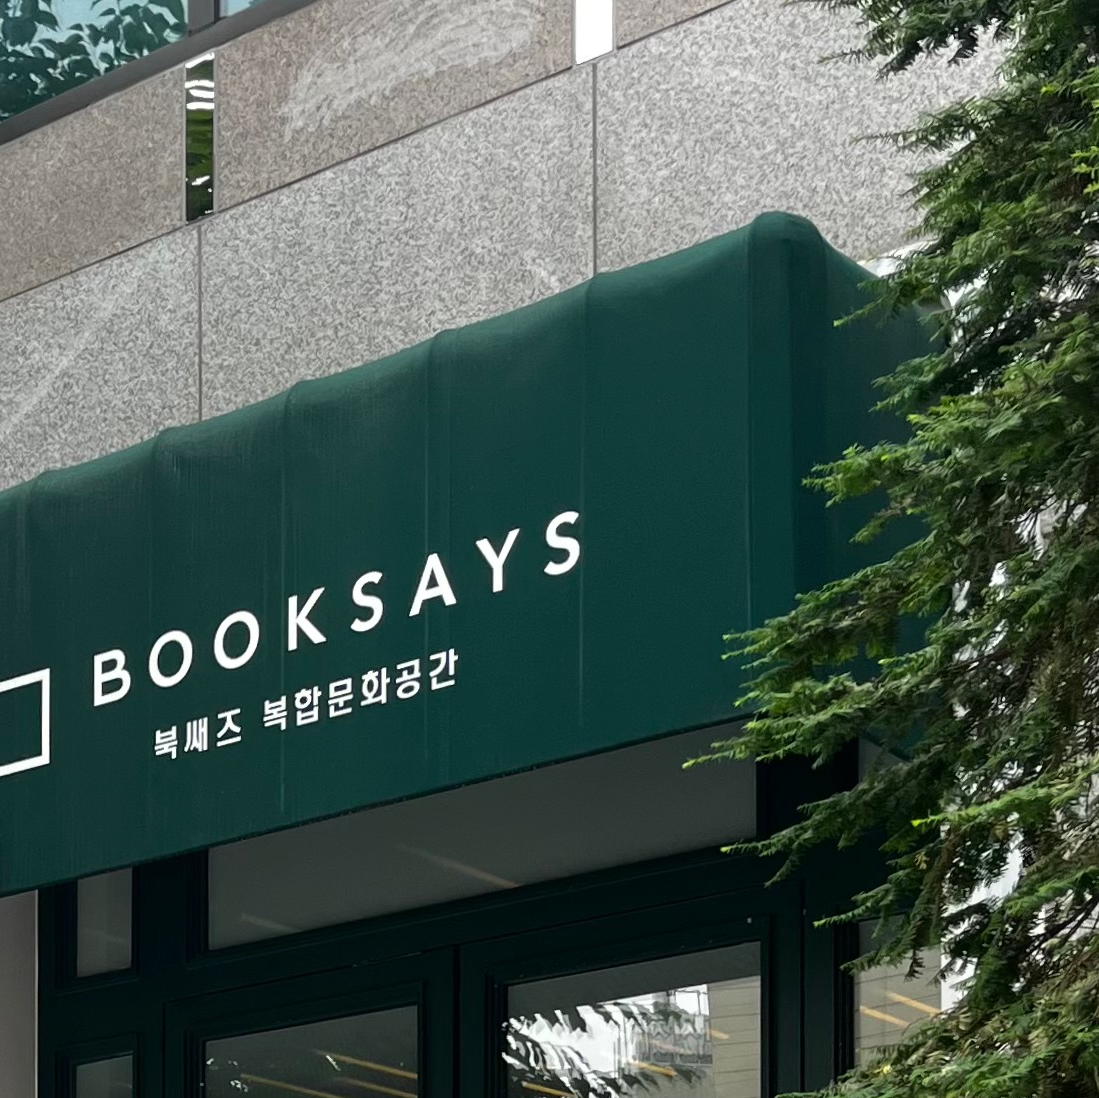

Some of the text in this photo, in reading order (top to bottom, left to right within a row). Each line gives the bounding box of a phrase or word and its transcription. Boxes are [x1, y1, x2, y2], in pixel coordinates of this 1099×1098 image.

[93, 511, 581, 707] BOOKSAYS
[154, 648, 459, 760] 북쌔즈 복합문화공간
